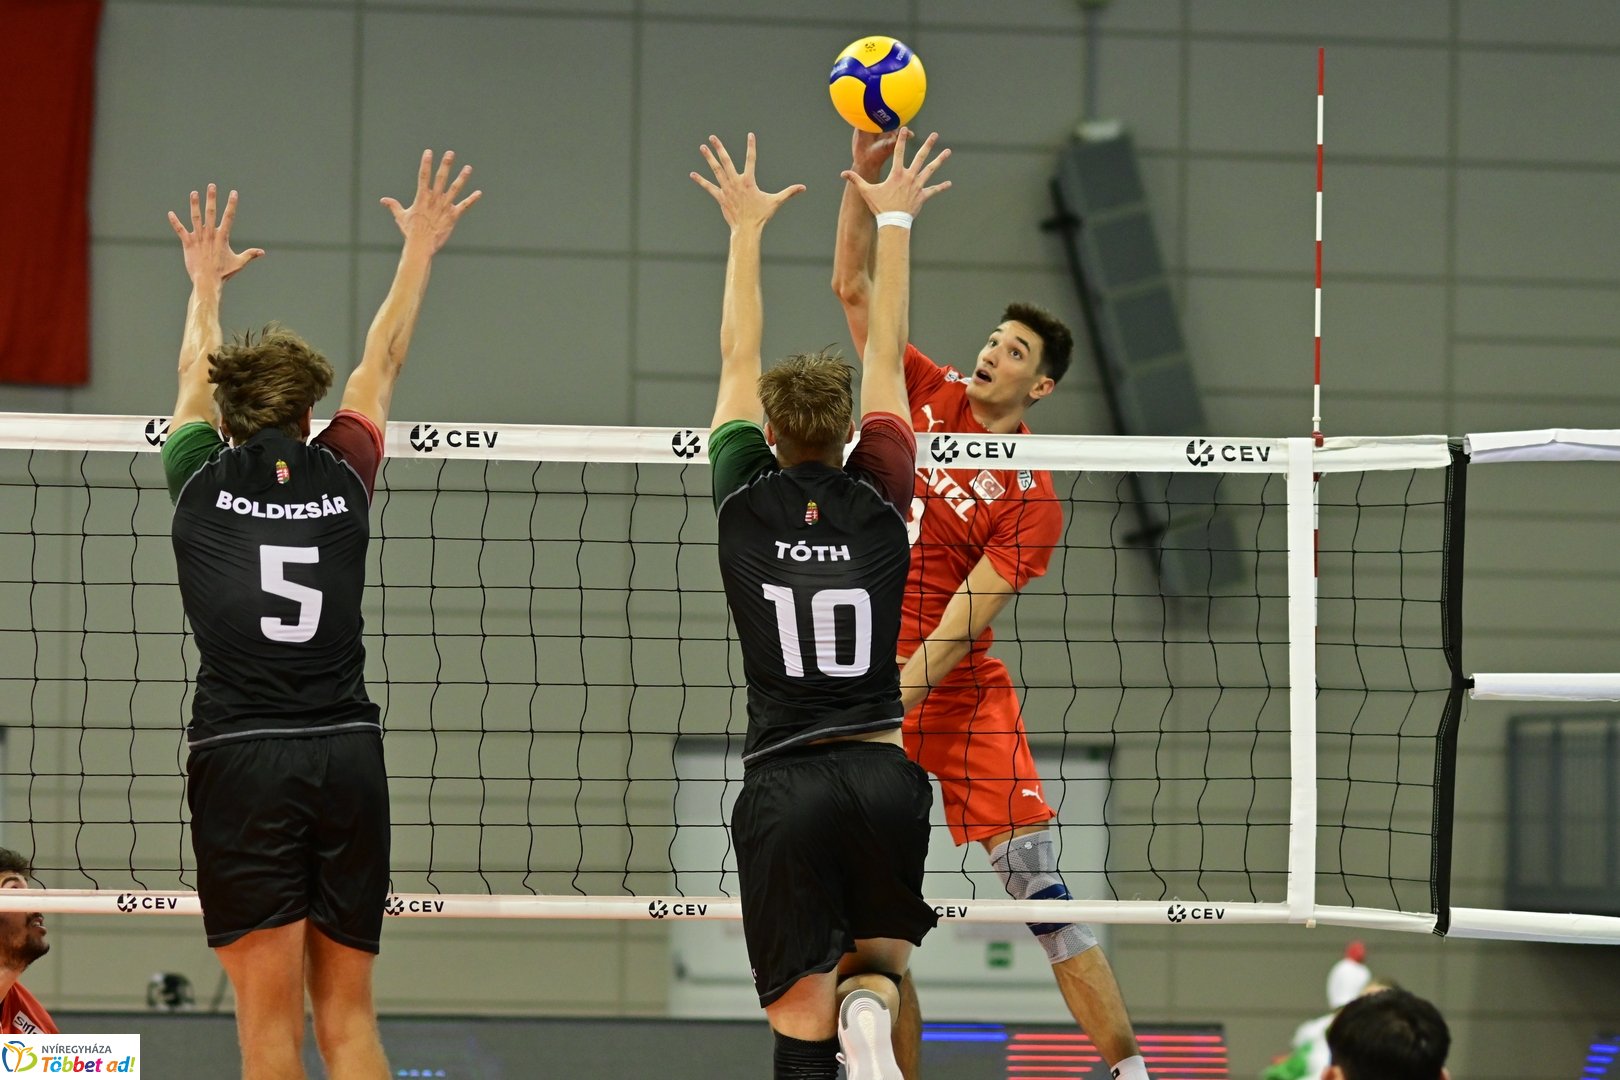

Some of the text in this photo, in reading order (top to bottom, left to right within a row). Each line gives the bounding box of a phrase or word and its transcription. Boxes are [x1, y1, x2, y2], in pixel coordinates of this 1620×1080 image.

[446, 430, 499, 449] CEV
[966, 442, 1017, 459] CEV
[1221, 445, 1271, 462] CEV
[215, 490, 349, 520] BOLDIZSÁR
[774, 540, 851, 562] TÓTH
[259, 544, 323, 643] 5
[761, 583, 872, 678] 10
[141, 896, 178, 910] CEV
[408, 900, 445, 913] CEV
[672, 903, 708, 917] CEV
[933, 905, 968, 918] CEV
[1190, 907, 1226, 920] CEV
